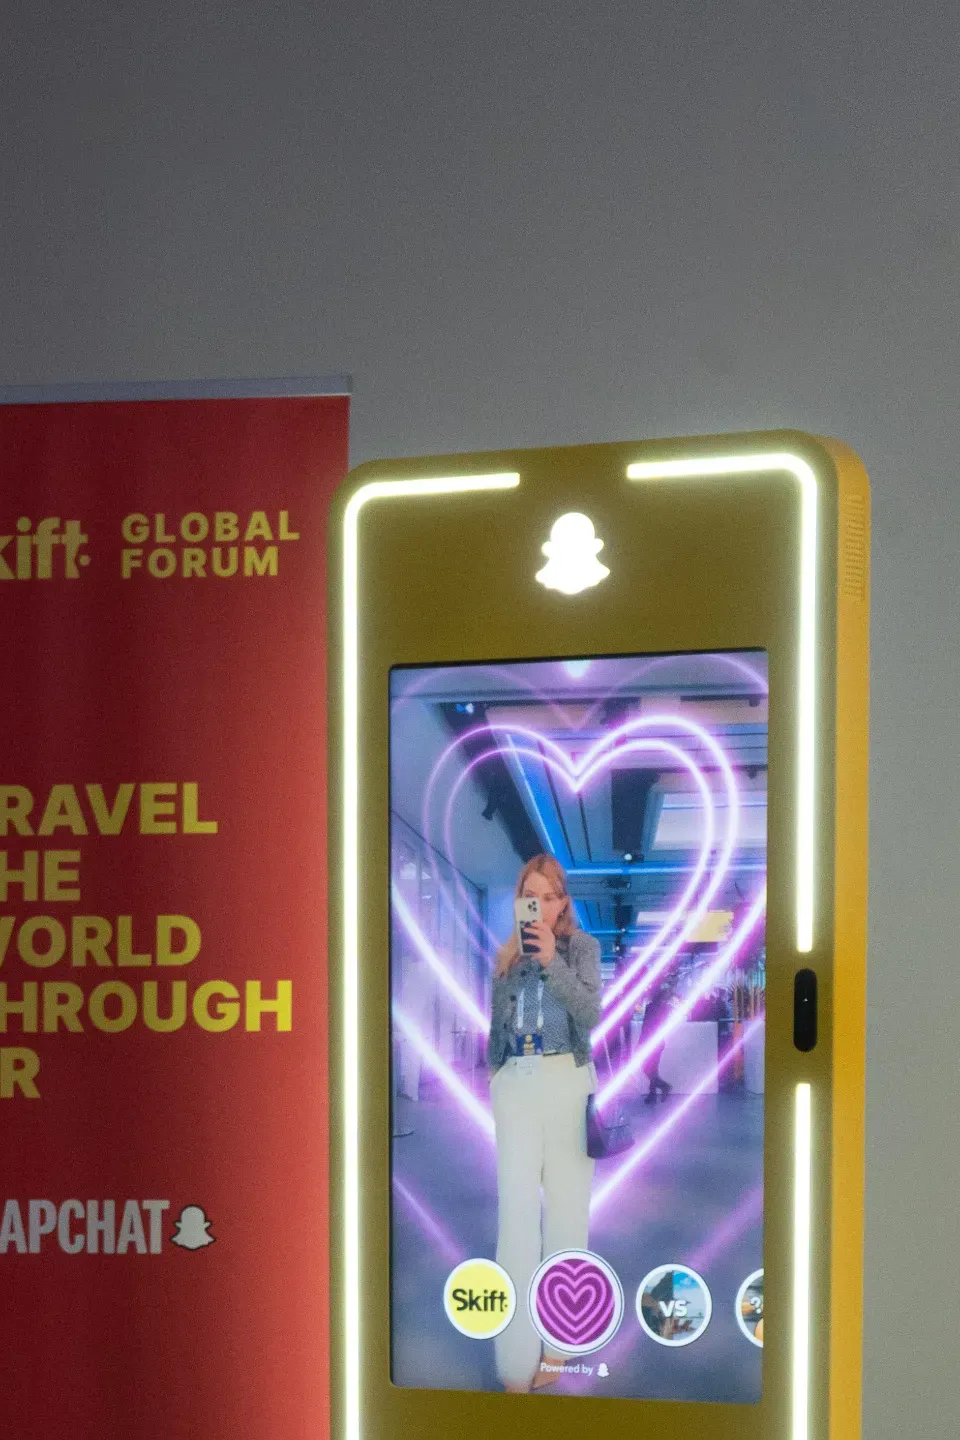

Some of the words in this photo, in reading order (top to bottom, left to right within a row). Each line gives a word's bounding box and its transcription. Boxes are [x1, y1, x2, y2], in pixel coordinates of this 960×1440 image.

[121, 510, 300, 543] GLOBAL
[122, 547, 279, 579] FORUM
[540, 1362, 579, 1374] Powered
[581, 1363, 594, 1377] by
